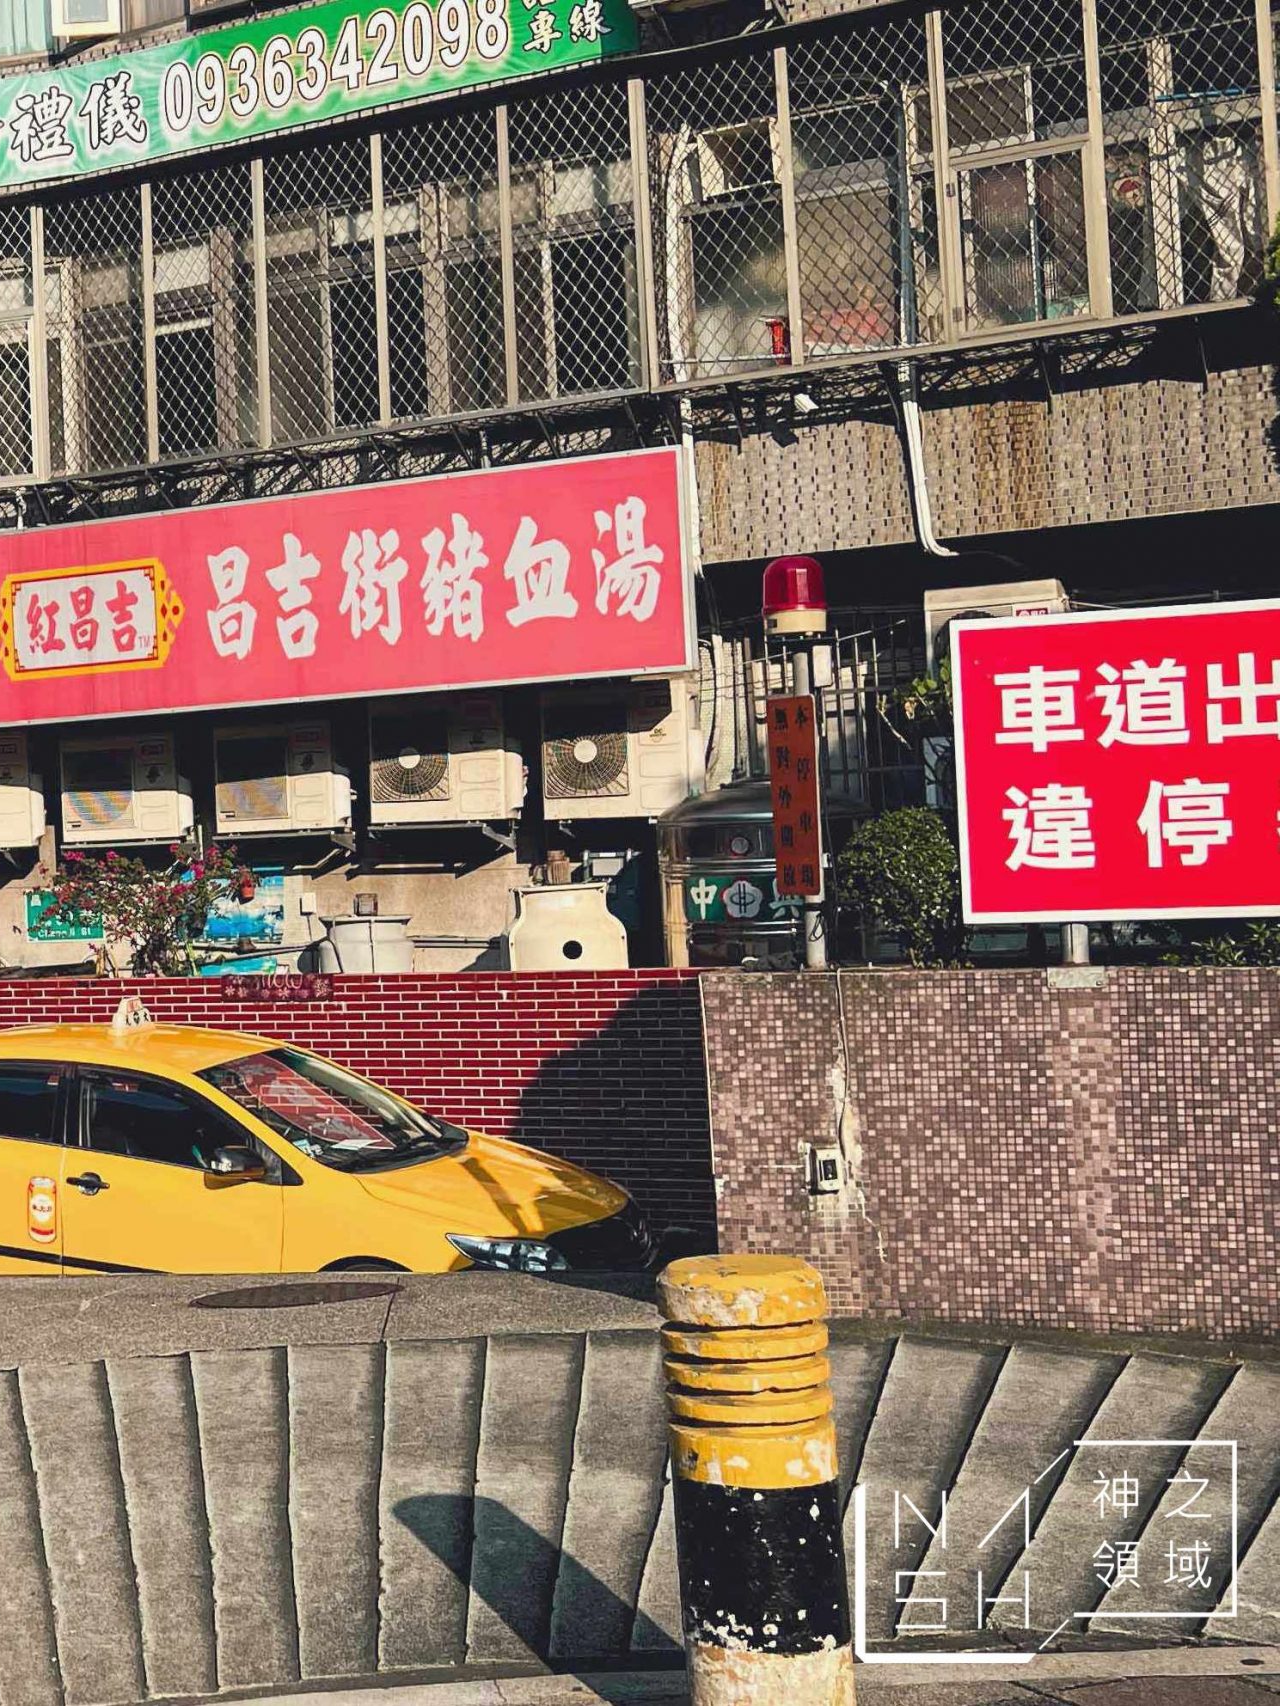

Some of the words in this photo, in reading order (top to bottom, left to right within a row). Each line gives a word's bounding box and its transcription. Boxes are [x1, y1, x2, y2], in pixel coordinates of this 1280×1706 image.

[164, 0, 510, 131] 0936342098
[26, 580, 139, 654] 紅昌吉
[206, 496, 664, 661] 昌吉街豬血湯
[1002, 777, 1280, 872] 違停
